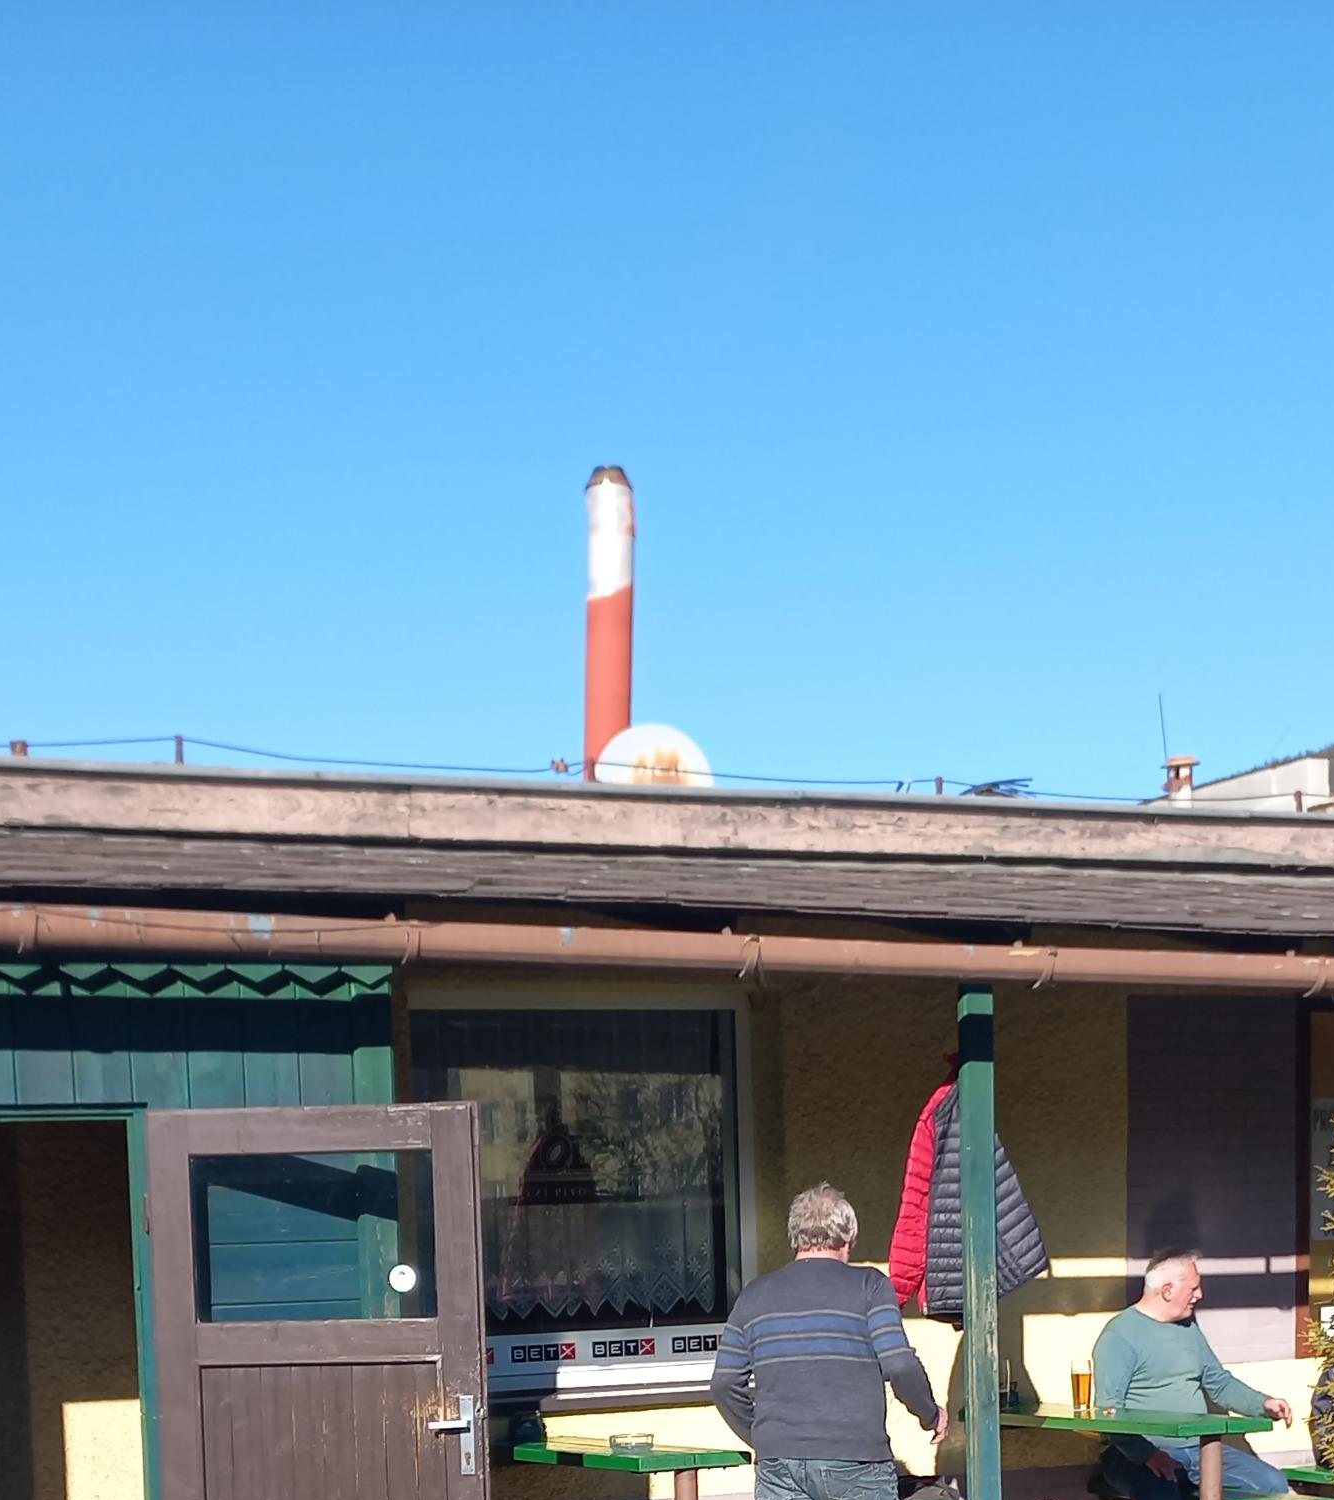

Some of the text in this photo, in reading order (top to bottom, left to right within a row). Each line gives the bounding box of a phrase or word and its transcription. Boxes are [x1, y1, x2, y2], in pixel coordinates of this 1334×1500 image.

[511, 1342, 576, 1361] BETX
[593, 1337, 655, 1356] BETX
[672, 1335, 719, 1352] BET
